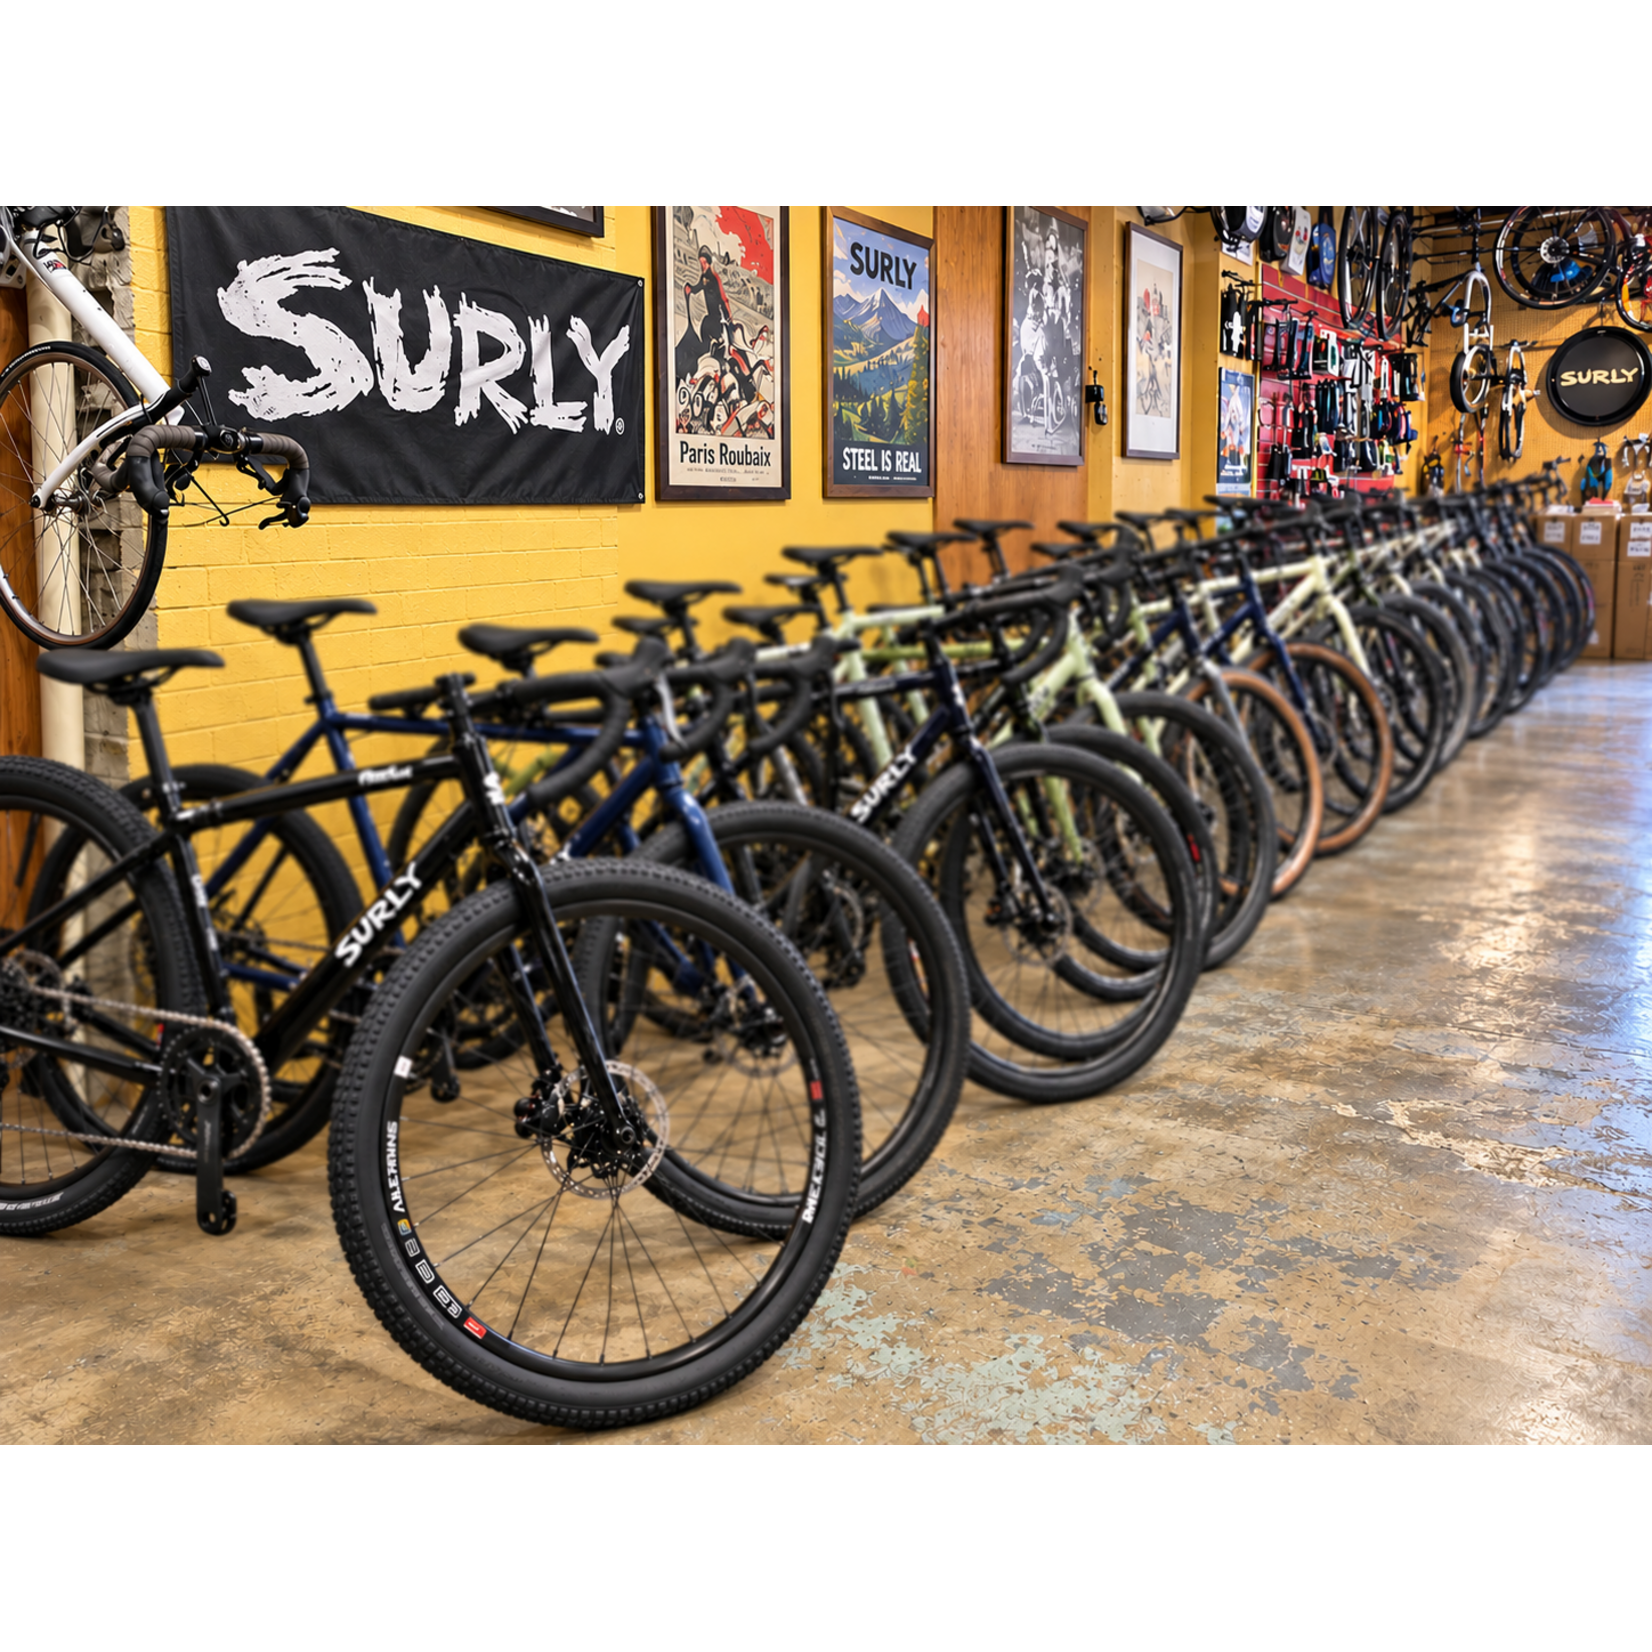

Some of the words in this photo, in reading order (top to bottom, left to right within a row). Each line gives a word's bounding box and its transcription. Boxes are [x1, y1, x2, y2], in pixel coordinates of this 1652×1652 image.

[850, 243, 917, 290] SURLY
[1560, 367, 1639, 386] SURLY
[680, 440, 715, 466] Paris
[719, 442, 771, 468] Roubaix
[842, 445, 878, 472] STEEL
[881, 449, 892, 473] IS
[895, 450, 922, 475] REAL
[850, 743, 917, 824] SURLY
[334, 860, 422, 968] SURLY
